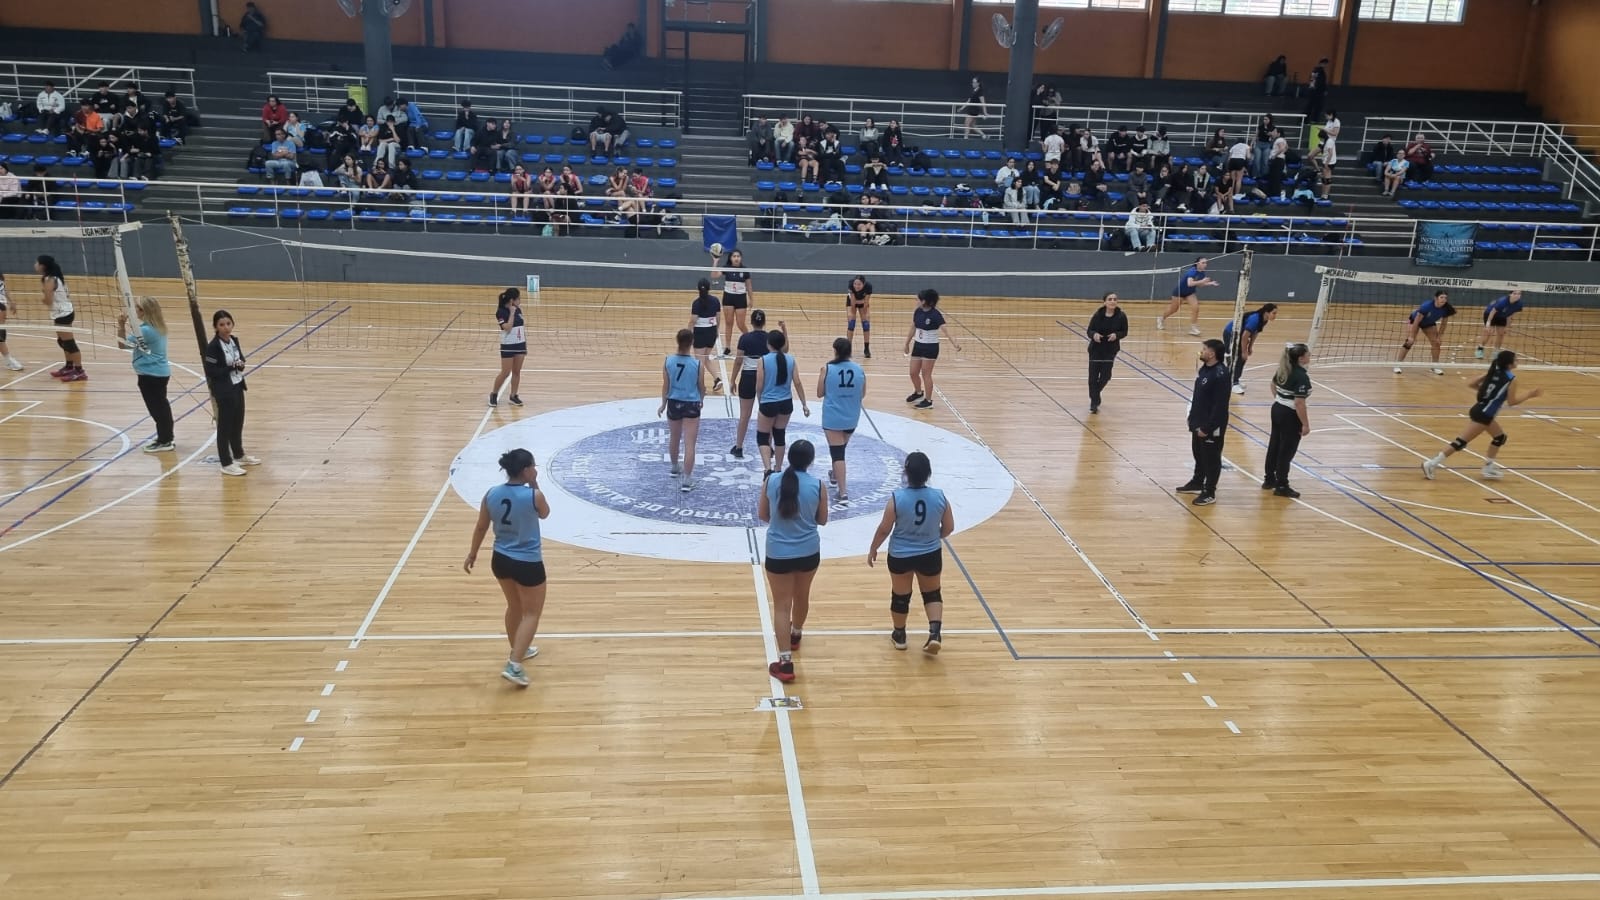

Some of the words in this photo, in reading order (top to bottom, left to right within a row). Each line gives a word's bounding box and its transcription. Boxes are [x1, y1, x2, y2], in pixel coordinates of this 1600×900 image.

[1428, 278, 1451, 286] MUNICIPAL
[1458, 279, 1473, 287] VOLEY
[1555, 285, 1577, 293] MUNICIPAL
[676, 363, 685, 381] 7
[838, 369, 855, 388] 12
[501, 498, 512, 525] 2
[633, 500, 665, 512] DE
[914, 499, 927, 526] 9
